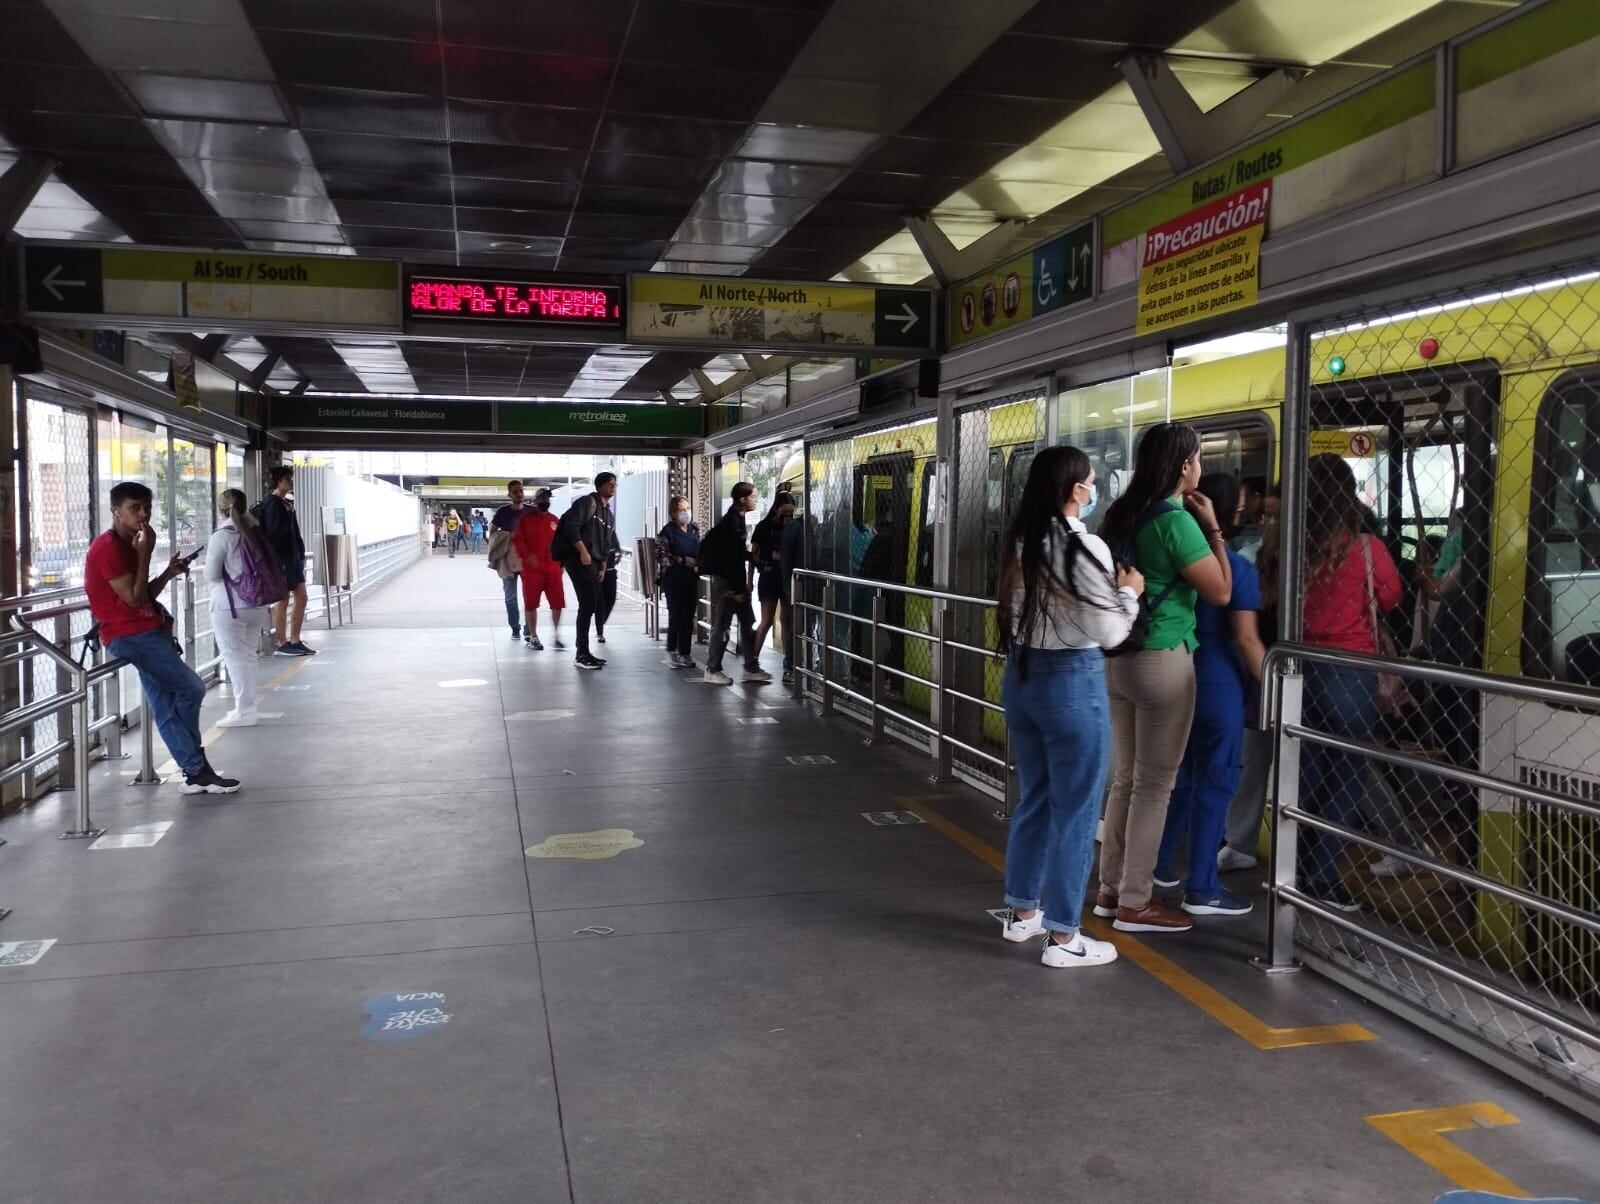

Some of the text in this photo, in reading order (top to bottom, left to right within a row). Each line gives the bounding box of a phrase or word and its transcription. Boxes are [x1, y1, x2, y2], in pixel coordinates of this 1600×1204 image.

[1191, 174, 1226, 204] Rutas
[1236, 147, 1283, 185] Routes
[1146, 187, 1269, 262] ¡Precaución!
[194, 260, 210, 277] Al
[214, 261, 244, 278] Sur
[257, 263, 307, 281] South
[1153, 266, 1166, 278] Por
[1166, 262, 1175, 273] tu
[1175, 245, 1214, 270] seguridad
[1168, 275, 1178, 287] de
[1180, 272, 1187, 283] la
[1208, 253, 1242, 274] amarilla
[1244, 252, 1250, 264] y
[412, 283, 606, 305] AMANGA TE INFORMA
[699, 284, 712, 300] Al
[717, 285, 756, 301] Norte
[768, 287, 807, 304] North
[1140, 264, 1256, 312] evita que los menores de edad
[471, 298, 496, 312] DE
[505, 300, 530, 315] LA
[540, 302, 606, 317] TARIFA
[1145, 289, 1246, 326] se acerquen a las puertas.
[318, 407, 351, 417] Estación
[351, 408, 389, 418] Cañaveral
[395, 409, 446, 419] Floridablanca
